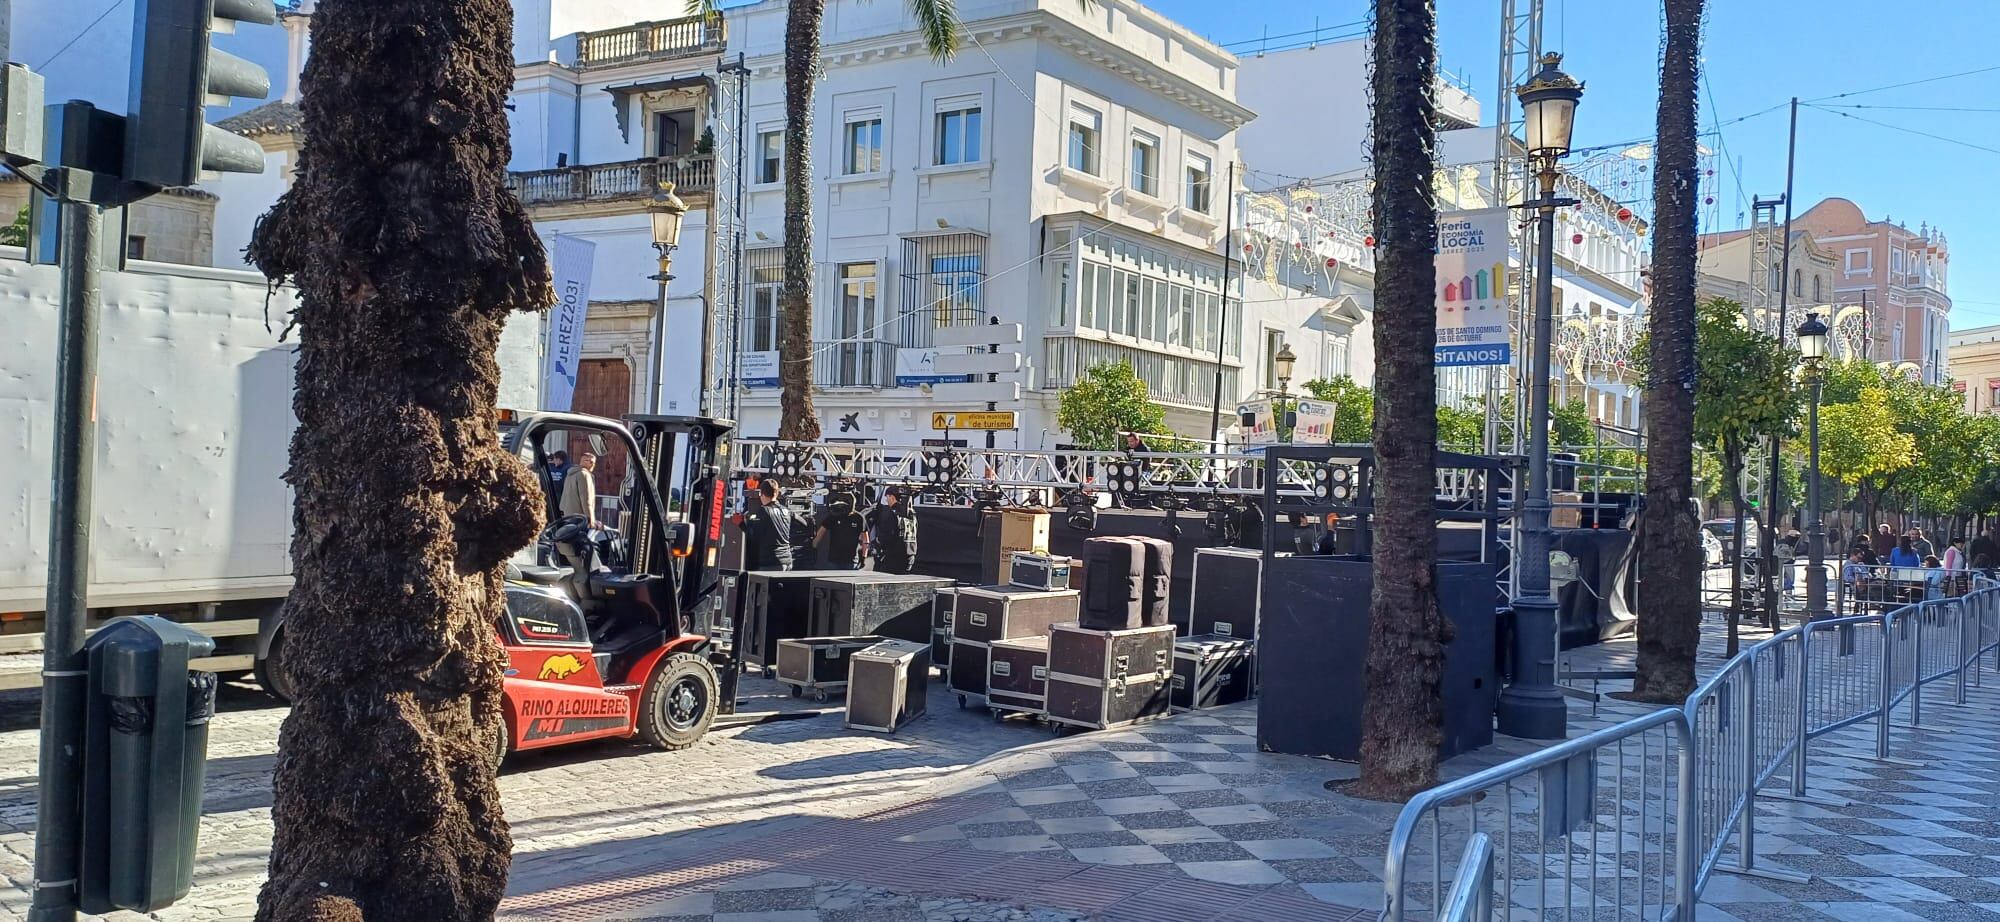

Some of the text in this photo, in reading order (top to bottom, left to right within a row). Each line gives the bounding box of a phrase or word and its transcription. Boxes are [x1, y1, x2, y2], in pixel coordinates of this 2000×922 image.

[1441, 220, 1471, 231] Feria
[1441, 229, 1484, 239] ECONOMÍA
[1442, 235, 1485, 248] LOCAL
[559, 279, 579, 363] JEREZ2031
[1456, 326, 1475, 334] SANTO
[1476, 325, 1502, 334] DOMINGO
[1447, 335, 1455, 343] DE
[1456, 334, 1482, 342] OCTUBRE
[973, 420, 1011, 428] de turismo
[710, 479, 725, 540] MANITOU
[521, 698, 628, 717] RINO ALQUILERES
[537, 718, 564, 733] MI
